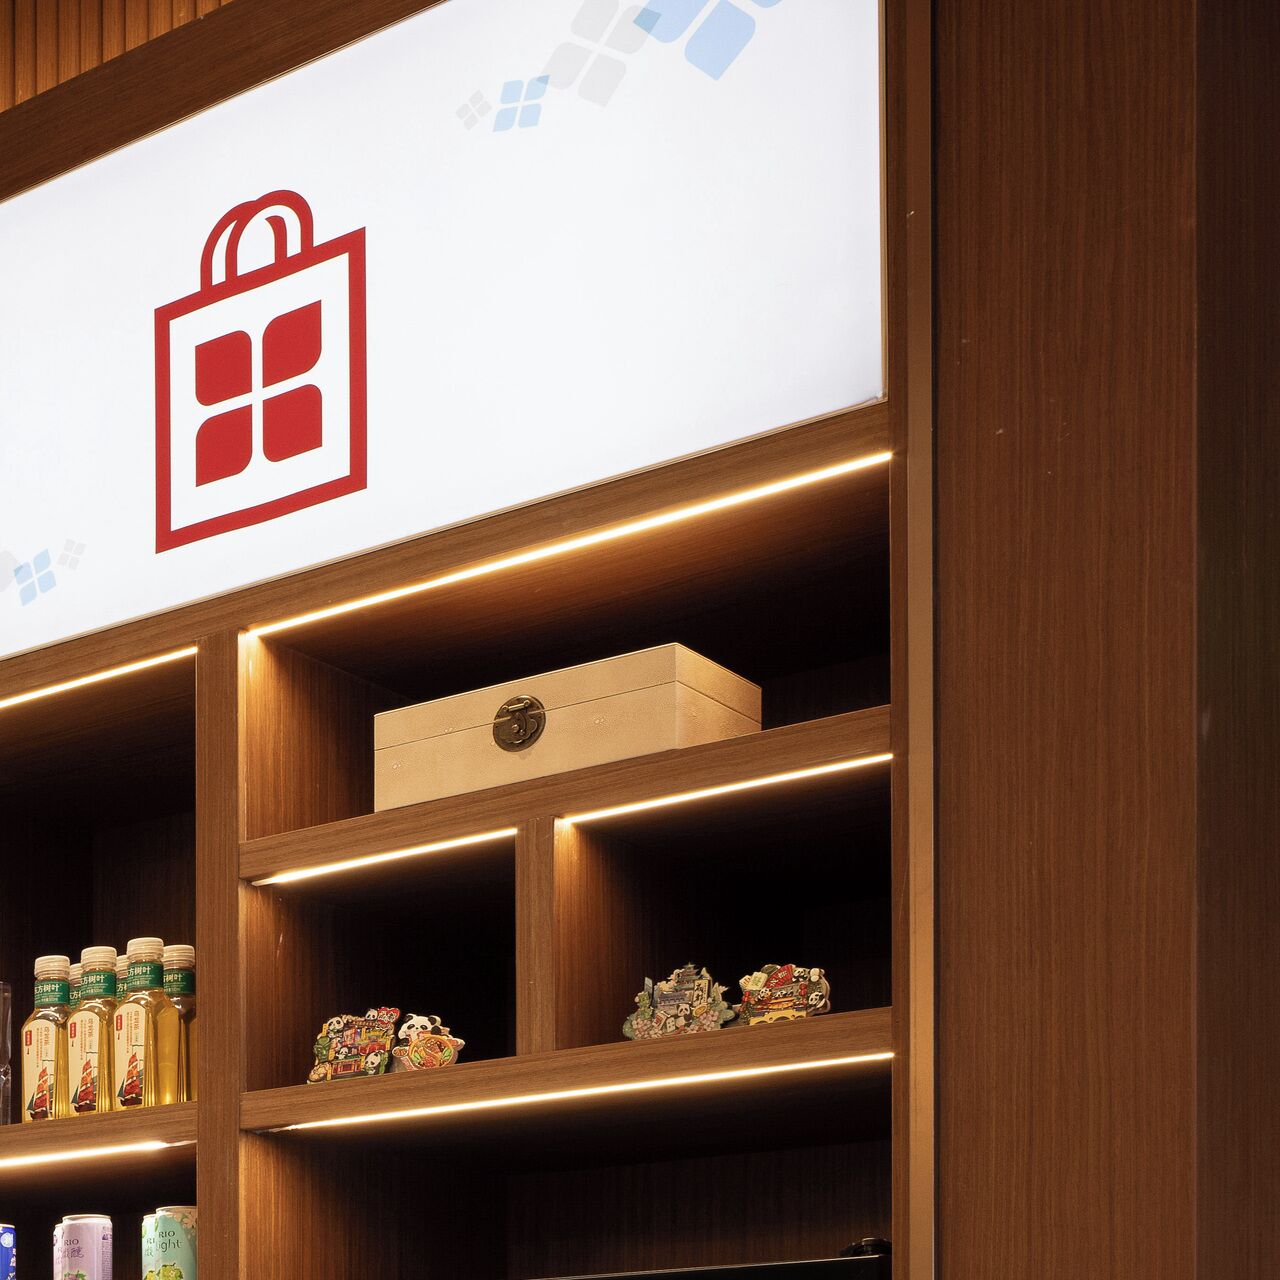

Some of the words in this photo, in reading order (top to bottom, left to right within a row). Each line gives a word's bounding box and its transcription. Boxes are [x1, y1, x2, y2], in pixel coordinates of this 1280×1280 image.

[127, 966, 151, 975] 方树叶
[81, 974, 104, 984] 方树叶
[159, 1230, 176, 1238] RIO
[64, 1238, 80, 1246] RIO
